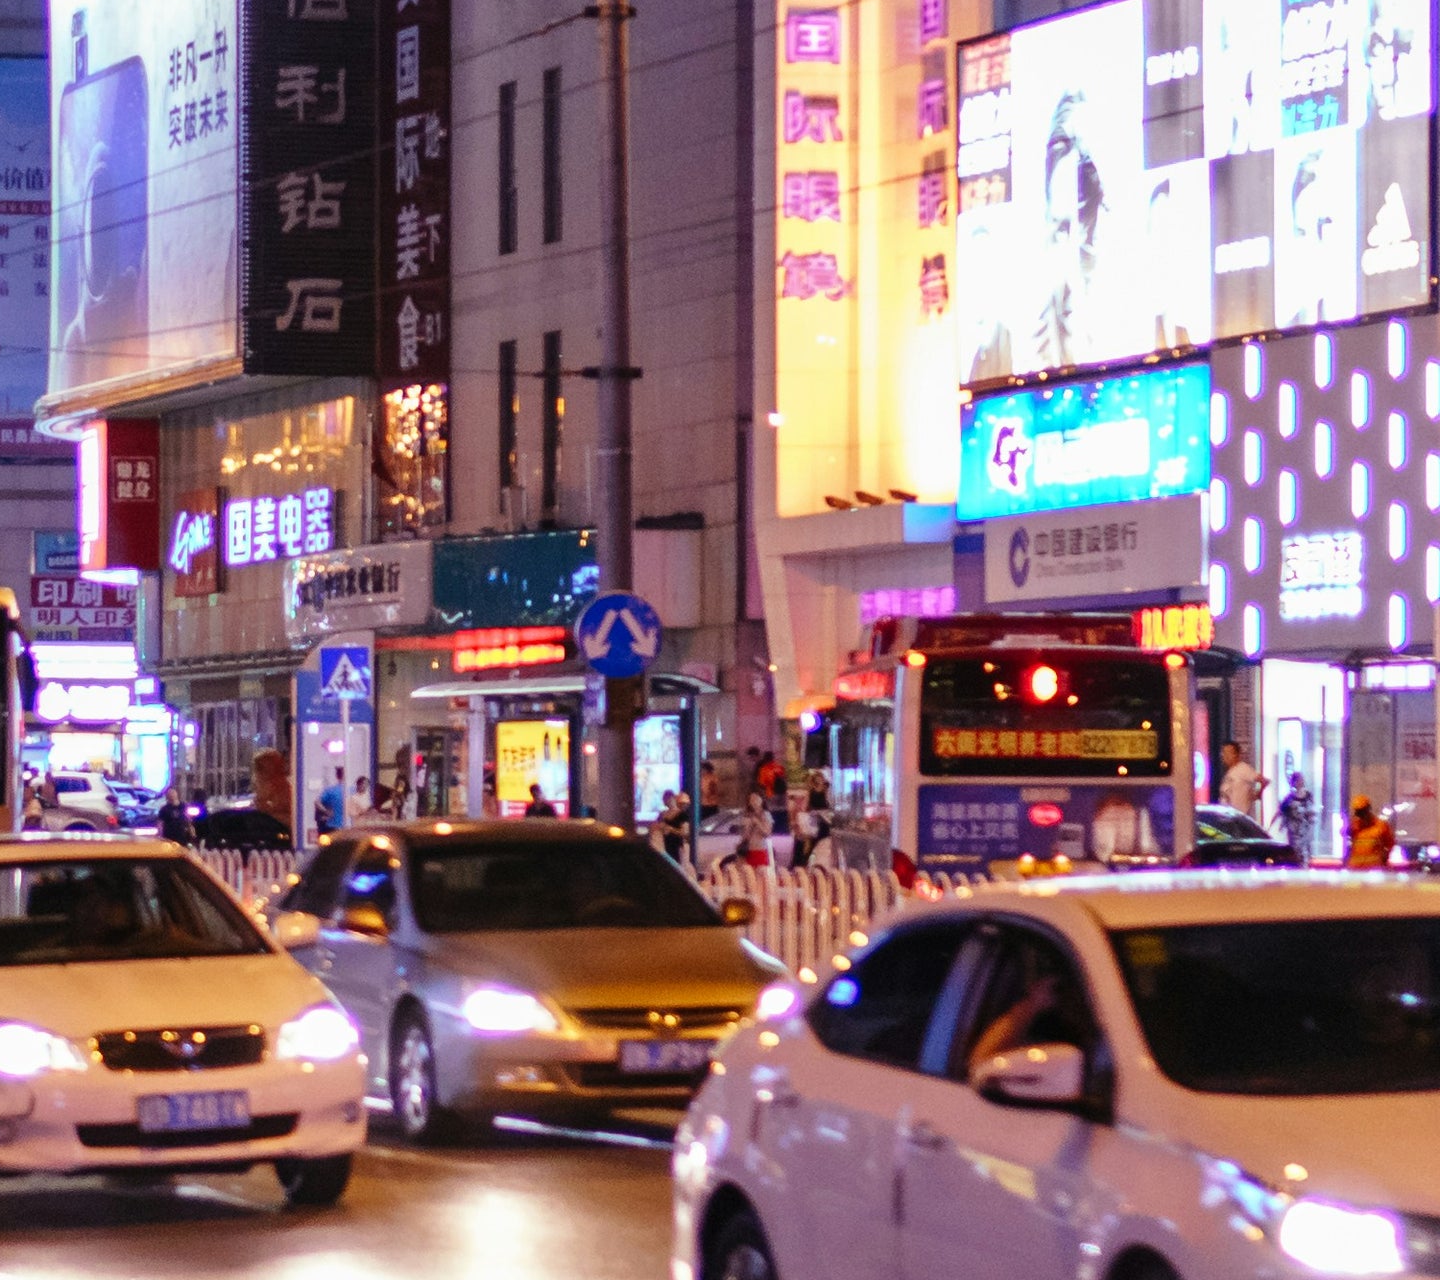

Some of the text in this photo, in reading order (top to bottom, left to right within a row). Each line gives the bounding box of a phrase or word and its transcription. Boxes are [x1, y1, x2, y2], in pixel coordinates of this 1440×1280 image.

[169, 88, 228, 150] 突破未来
[227, 487, 331, 565] 国美电器
[1033, 521, 1138, 559] 中国建设银行
[38, 579, 103, 607] 印刷
